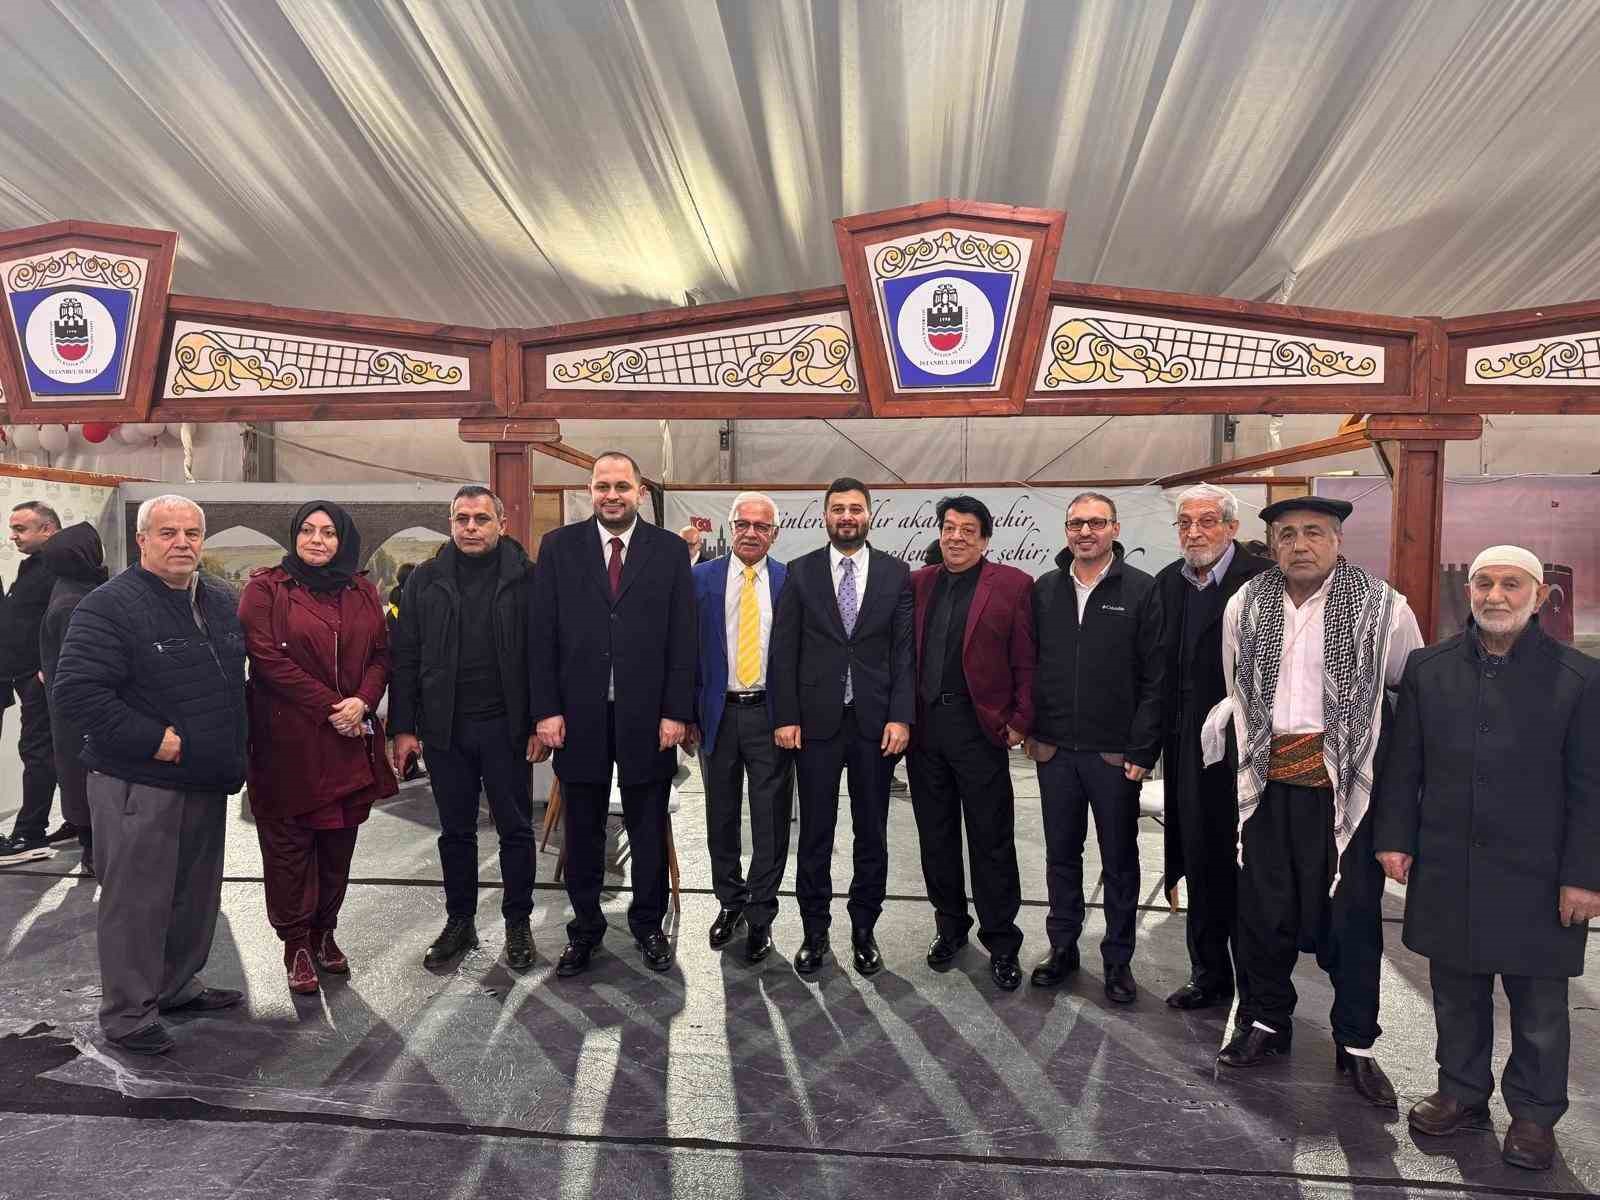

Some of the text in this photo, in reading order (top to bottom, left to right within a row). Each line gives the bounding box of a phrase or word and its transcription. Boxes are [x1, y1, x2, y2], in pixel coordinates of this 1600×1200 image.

[992, 495, 1035, 532] ehir,
[887, 528, 1050, 565] eden şehir;
